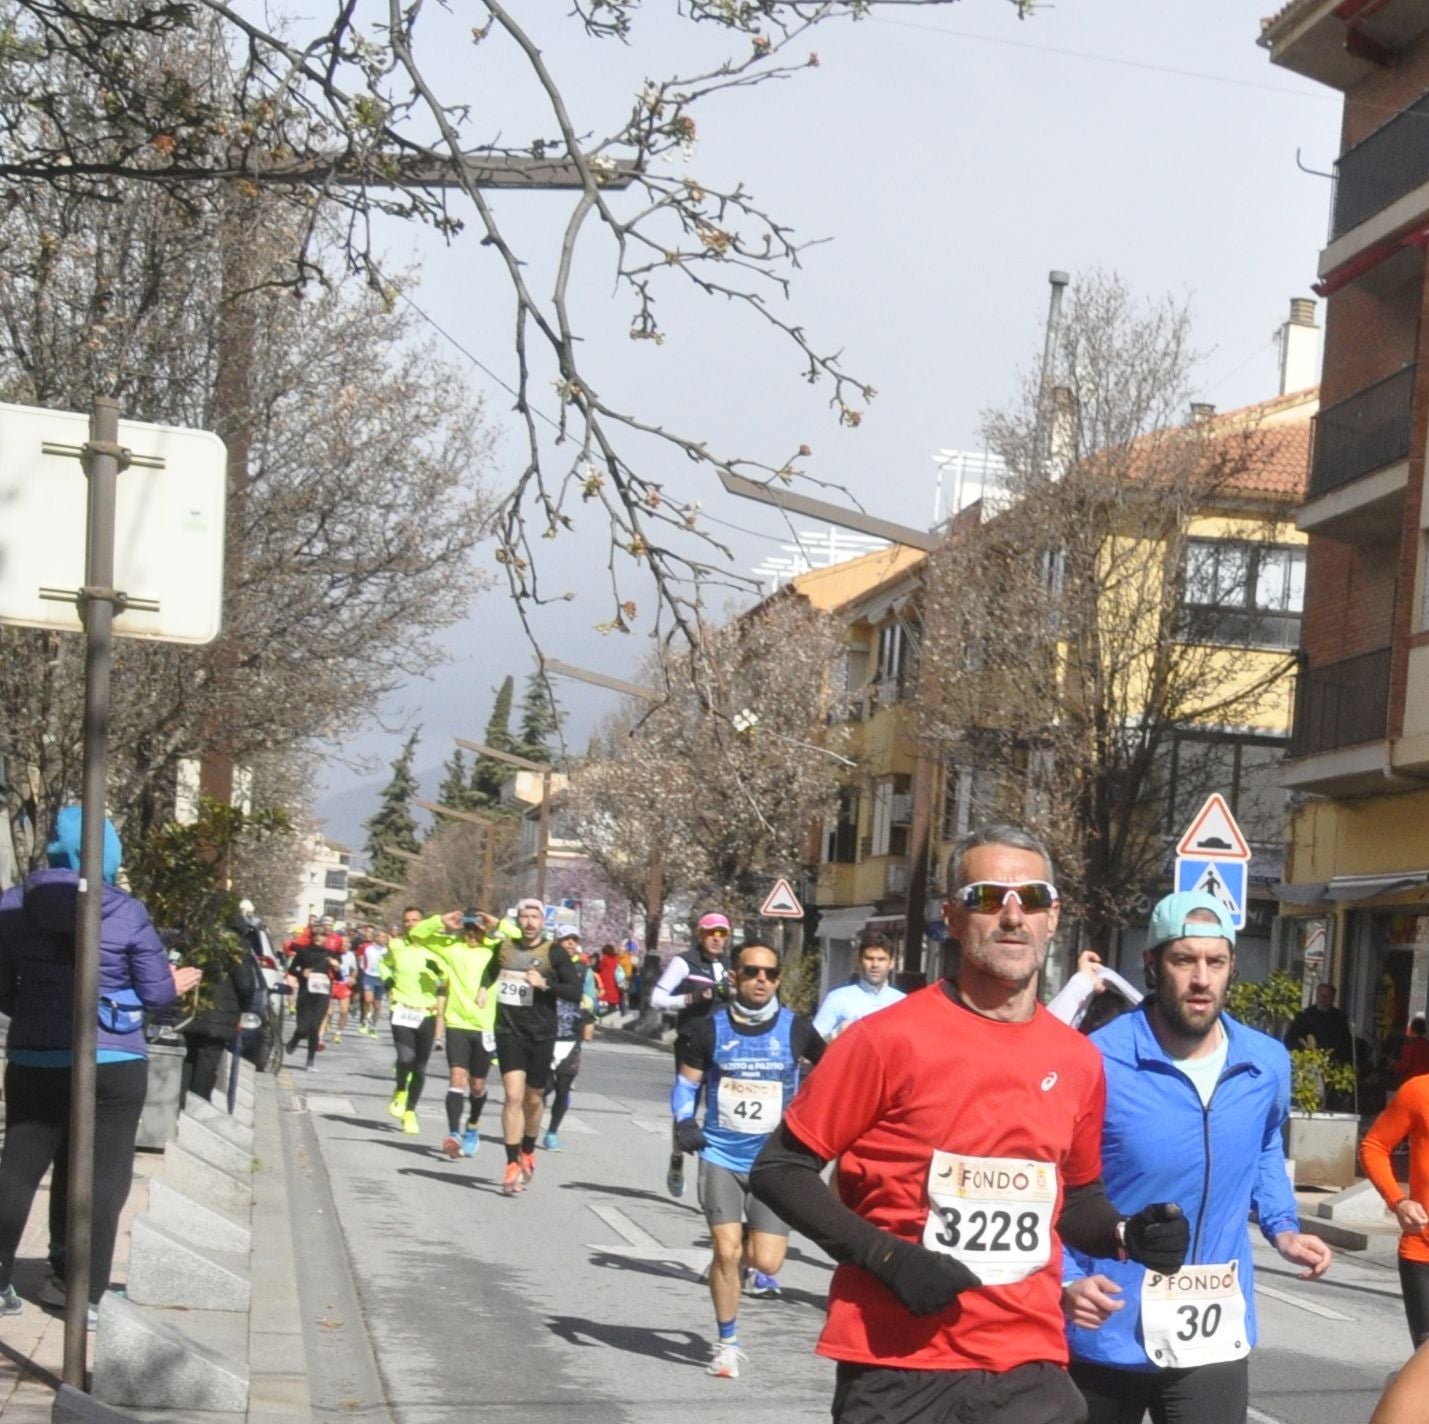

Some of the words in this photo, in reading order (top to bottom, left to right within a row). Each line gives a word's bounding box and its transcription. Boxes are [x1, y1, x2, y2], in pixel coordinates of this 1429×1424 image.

[734, 1100, 762, 1120] 42
[961, 1169, 1029, 1190] FONDO
[935, 1206, 1040, 1251] 3228
[1167, 1273, 1233, 1291] FONDO
[1176, 1303, 1222, 1341] 30
